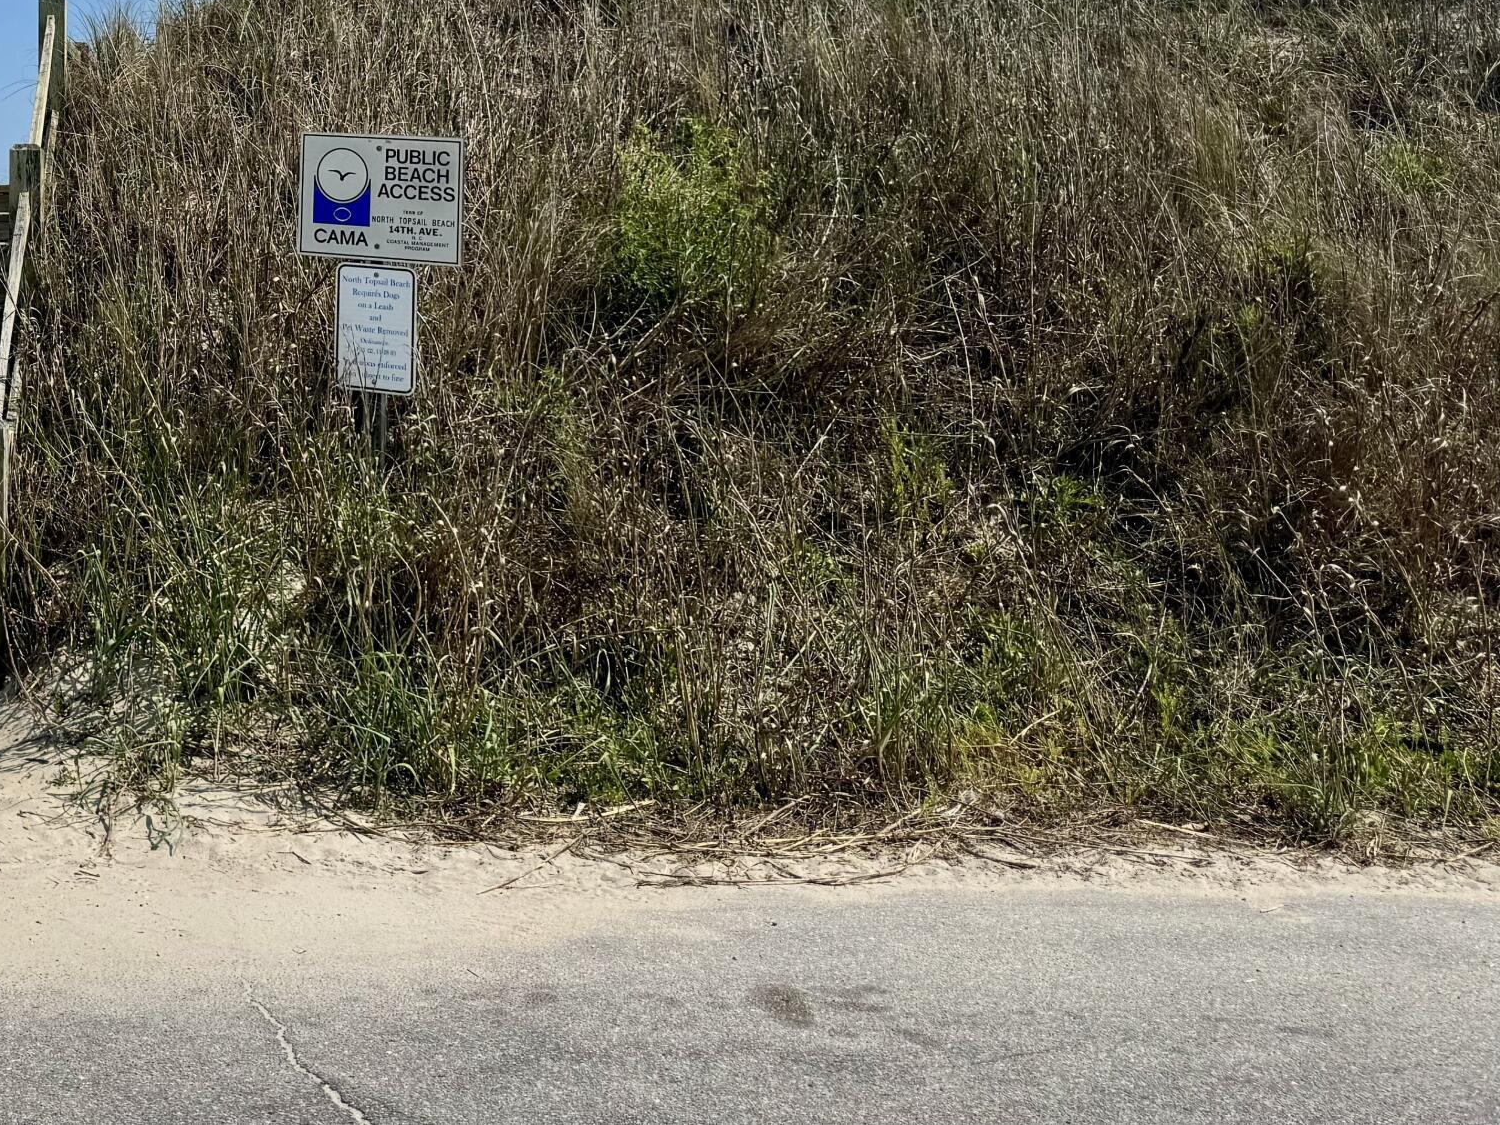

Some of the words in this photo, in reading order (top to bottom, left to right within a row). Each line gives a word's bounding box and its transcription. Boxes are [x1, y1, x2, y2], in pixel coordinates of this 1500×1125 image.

[385, 148, 450, 166] PUBLIC
[384, 166, 450, 184] BEACH
[377, 184, 455, 202] ACCESS
[372, 216, 394, 224] NORTH
[399, 217, 427, 226] TOPSAIL
[432, 219, 455, 227] BEACH
[314, 228, 368, 247] CAMA
[389, 225, 416, 235] 14TH.
[419, 228, 443, 237] AVE.
[342, 275, 362, 284] North
[364, 277, 389, 287] Topsail
[390, 280, 410, 288] Beach
[383, 291, 400, 299] Dogs
[374, 302, 394, 311] Leash
[355, 324, 376, 334] Waste
[377, 327, 409, 337] Removed
